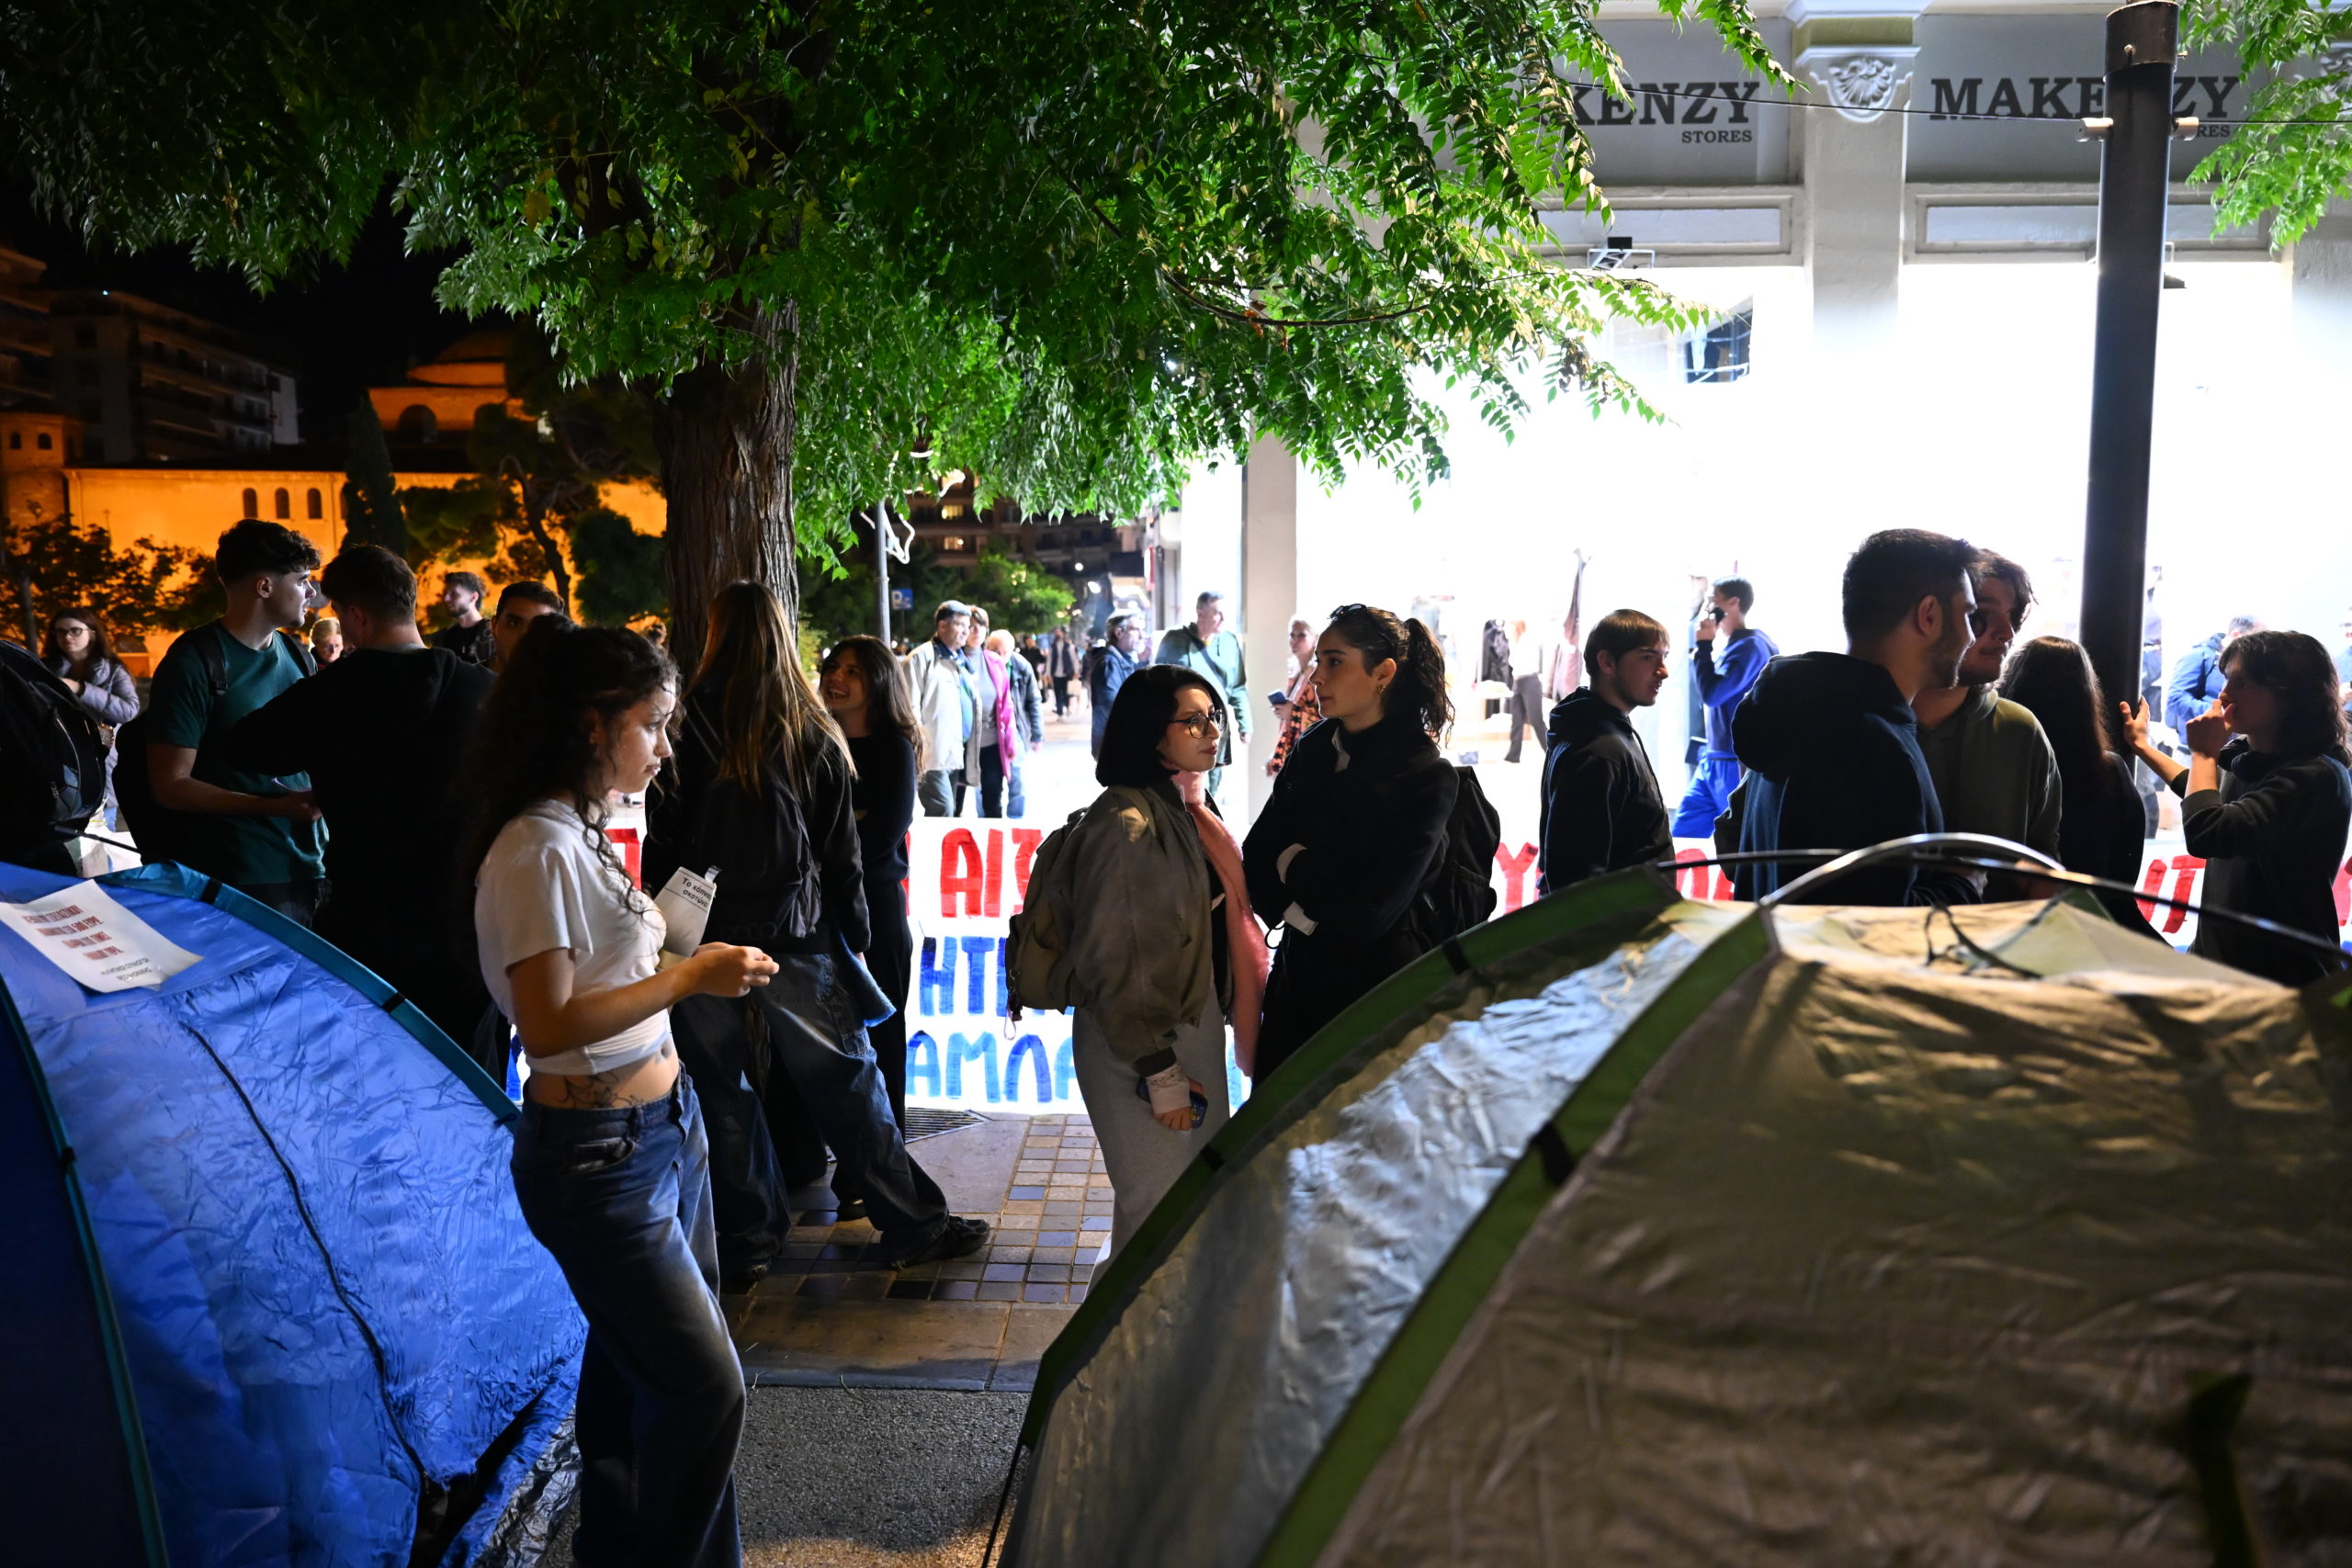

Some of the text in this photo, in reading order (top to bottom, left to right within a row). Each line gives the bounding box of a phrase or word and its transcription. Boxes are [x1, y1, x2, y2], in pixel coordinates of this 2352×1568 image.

[1572, 82, 1760, 125] KENZY
[1930, 76, 2240, 120] MAKEZY
[1681, 130, 1752, 143] STORES
[683, 877, 692, 887] Το
